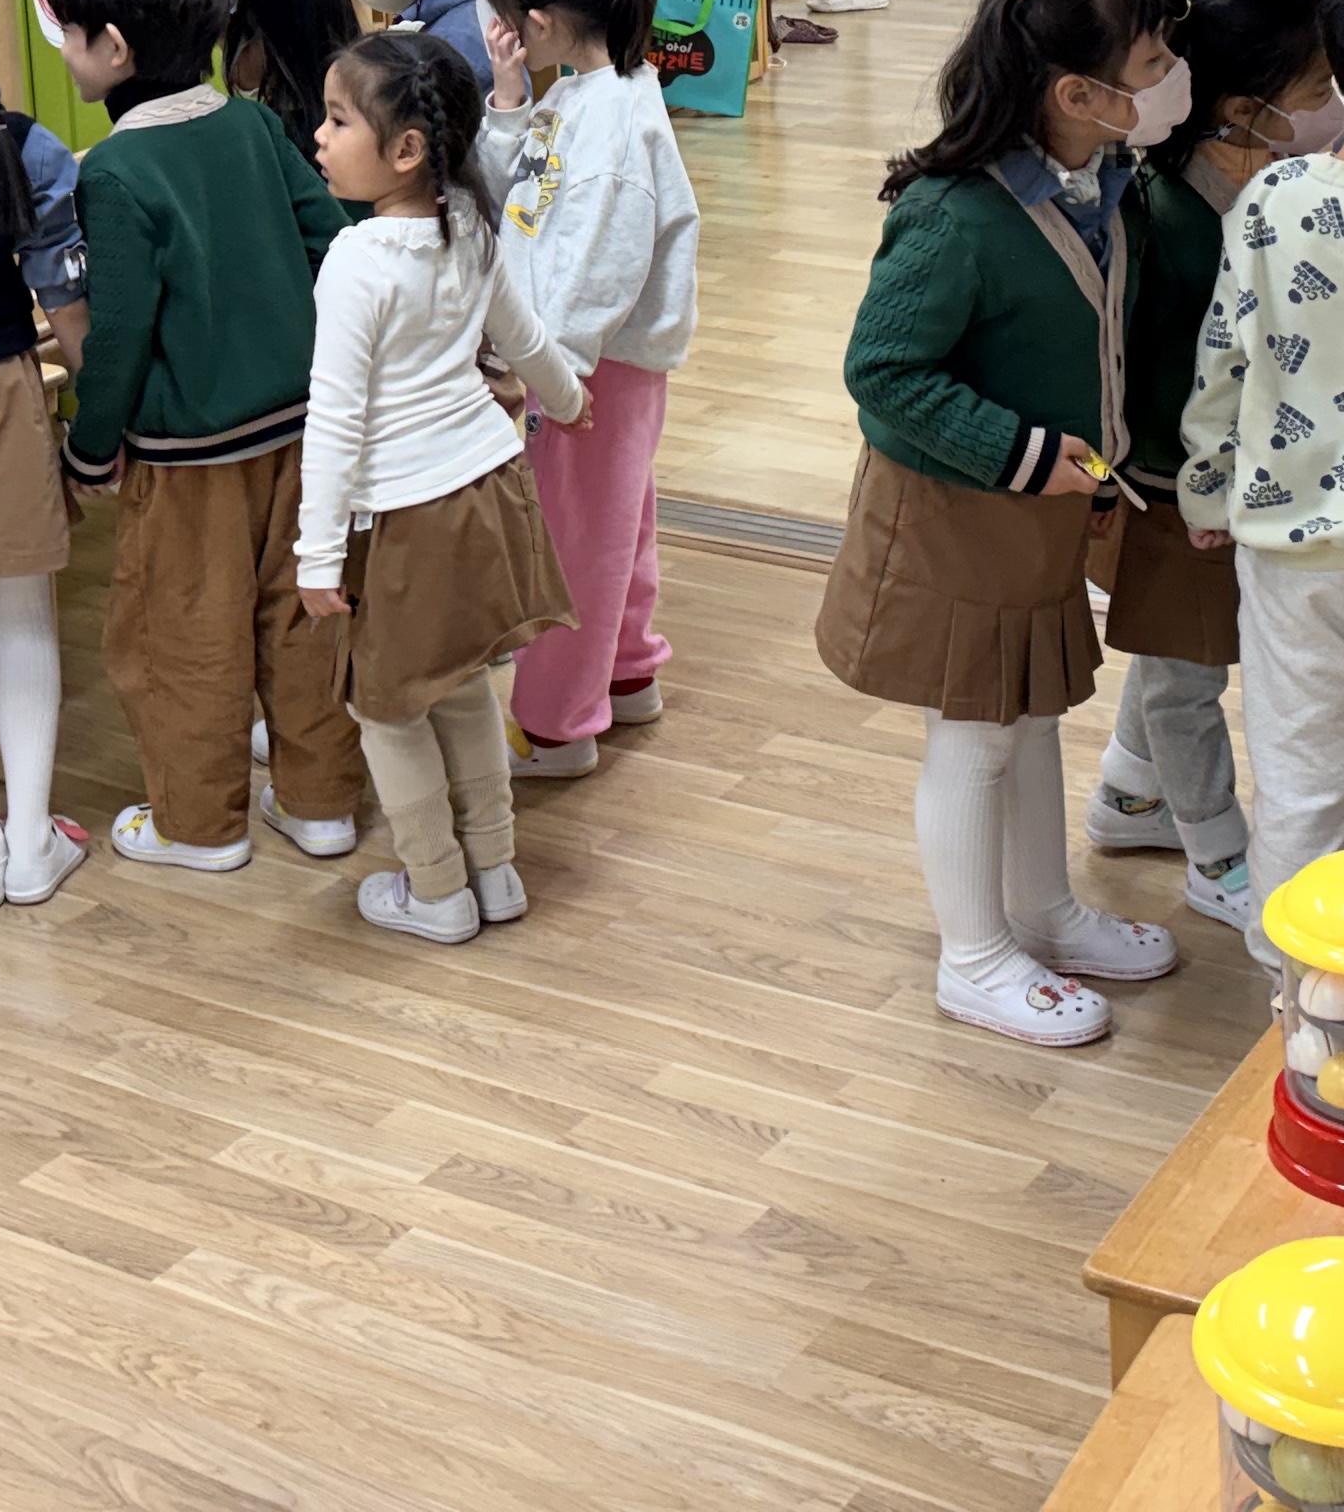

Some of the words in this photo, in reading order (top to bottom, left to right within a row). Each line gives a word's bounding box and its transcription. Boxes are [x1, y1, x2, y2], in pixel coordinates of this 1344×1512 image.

[666, 42, 693, 53] 아이
[1312, 208, 1331, 235] Cold
[1322, 198, 1341, 239] outside
[1291, 276, 1318, 301] Cold
[1293, 264, 1331, 300] outside
[1275, 334, 1289, 362] Cold
[1280, 333, 1302, 372] outside
[1274, 420, 1300, 443] Cold
[1276, 408, 1311, 439] outside
[1249, 481, 1281, 494] Cold
